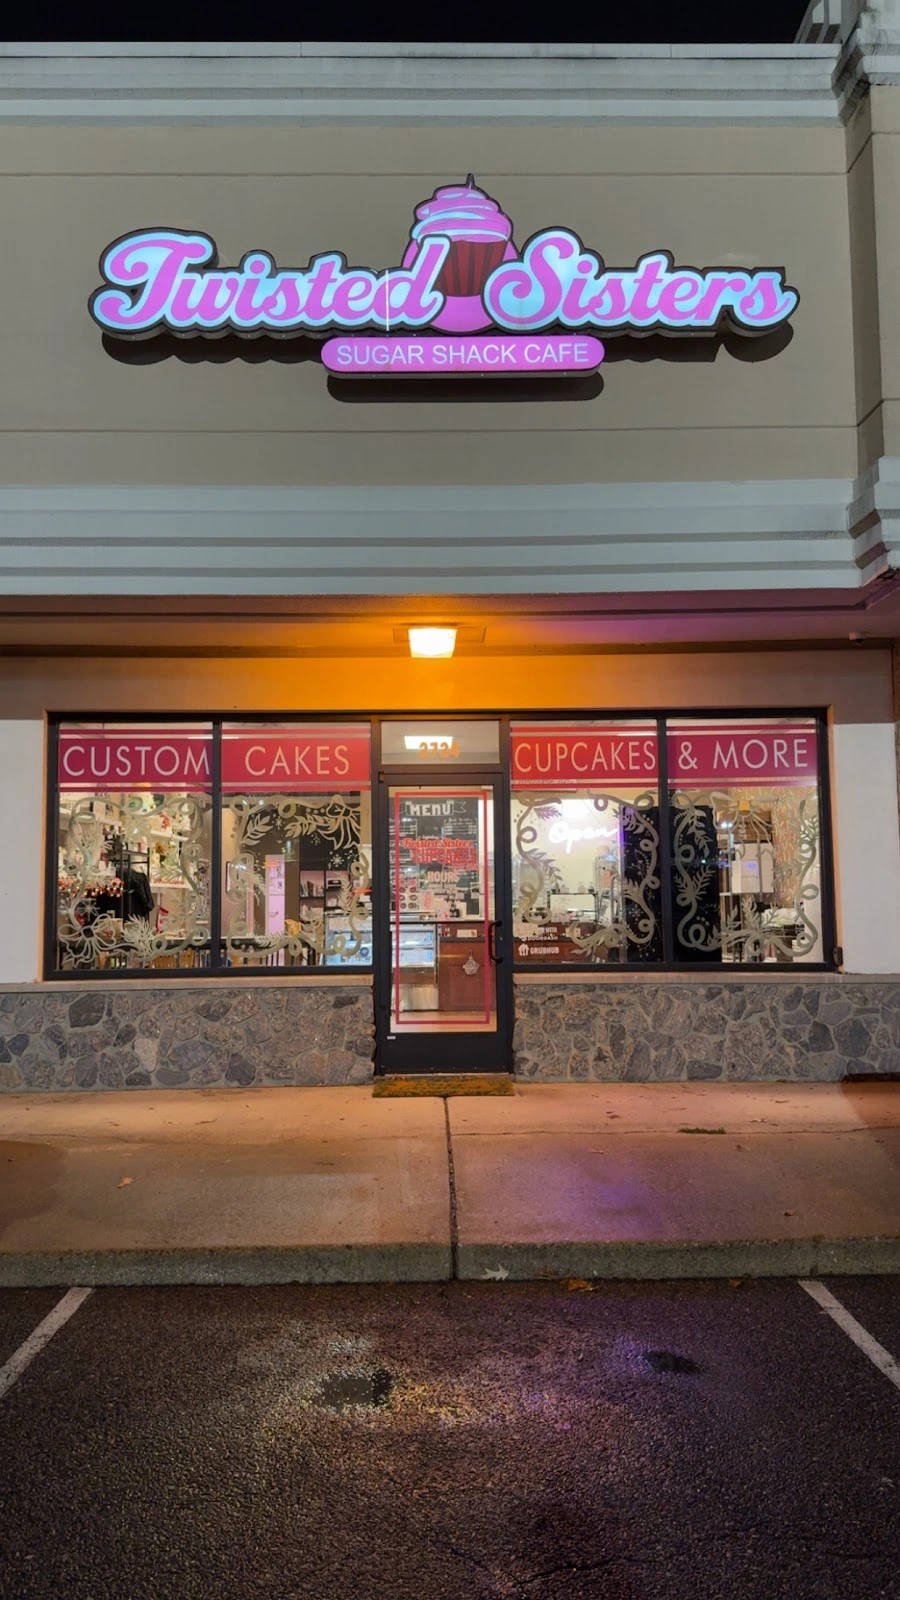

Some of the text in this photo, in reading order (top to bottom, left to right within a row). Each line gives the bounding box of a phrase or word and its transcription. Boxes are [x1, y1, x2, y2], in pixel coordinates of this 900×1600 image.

[97, 234, 794, 327] Twisted Sisters
[336, 342, 590, 366] SUGAR SHACK CAFE
[62, 744, 350, 777] CUSTOM CAKES
[514, 737, 809, 773] CUPCAKES & MORE
[410, 802, 451, 817] MENU
[547, 819, 619, 855] Open
[411, 848, 478, 864] CUPCAKES
[427, 870, 459, 882] HOURS
[529, 946, 560, 955] GRUBHUB
